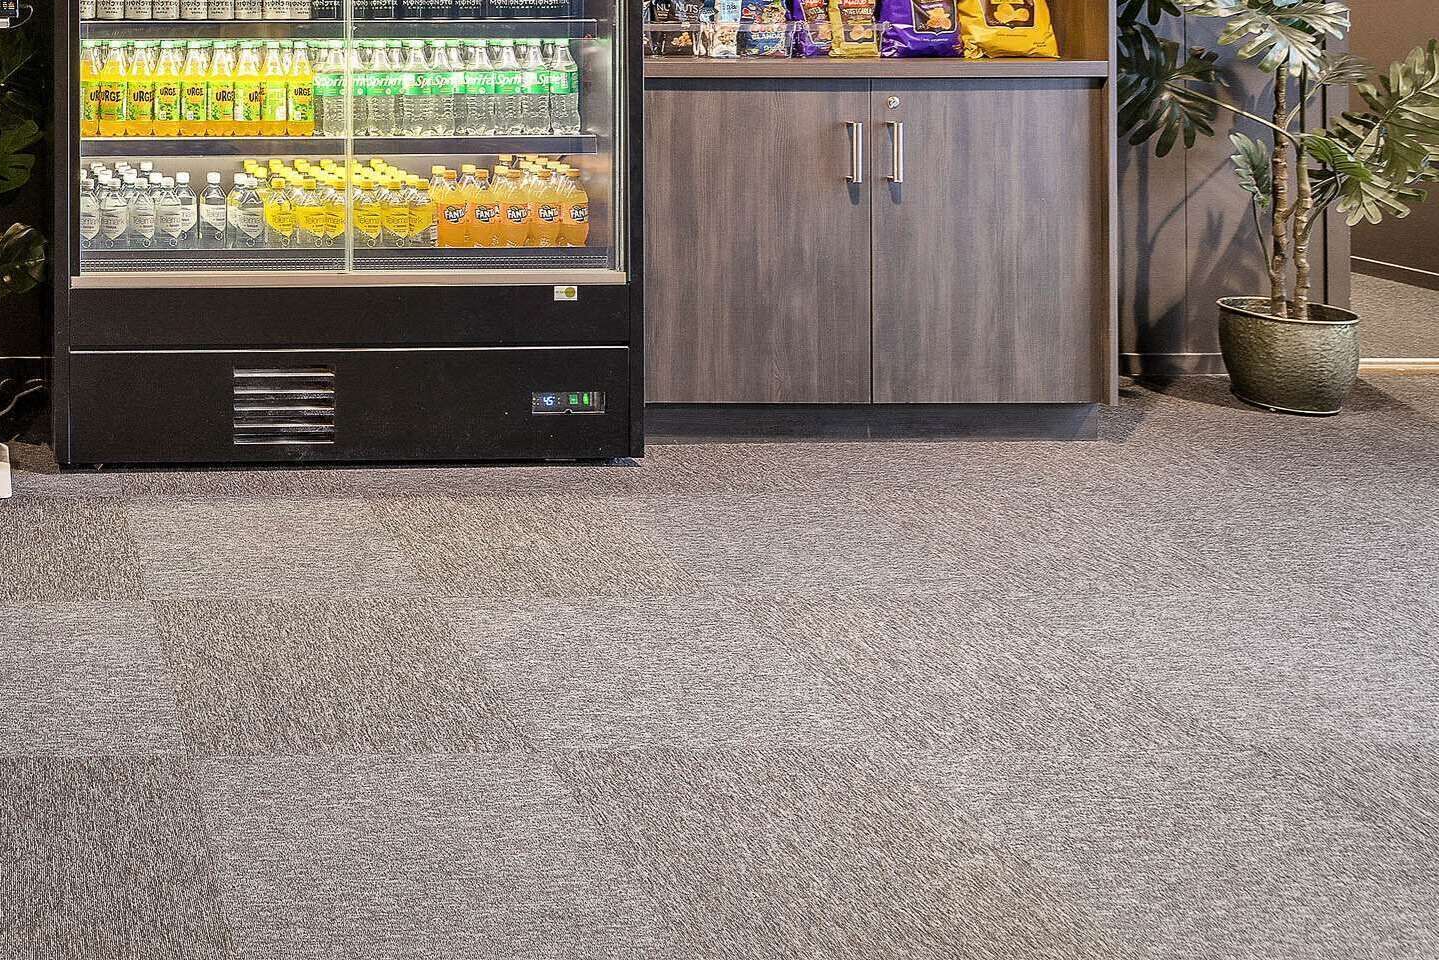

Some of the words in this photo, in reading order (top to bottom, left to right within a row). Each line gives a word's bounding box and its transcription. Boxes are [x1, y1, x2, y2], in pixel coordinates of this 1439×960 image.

[675, 3, 698, 13] NUTS
[160, 86, 177, 96] URGE
[186, 86, 205, 97] URGE
[294, 87, 312, 97] URGE
